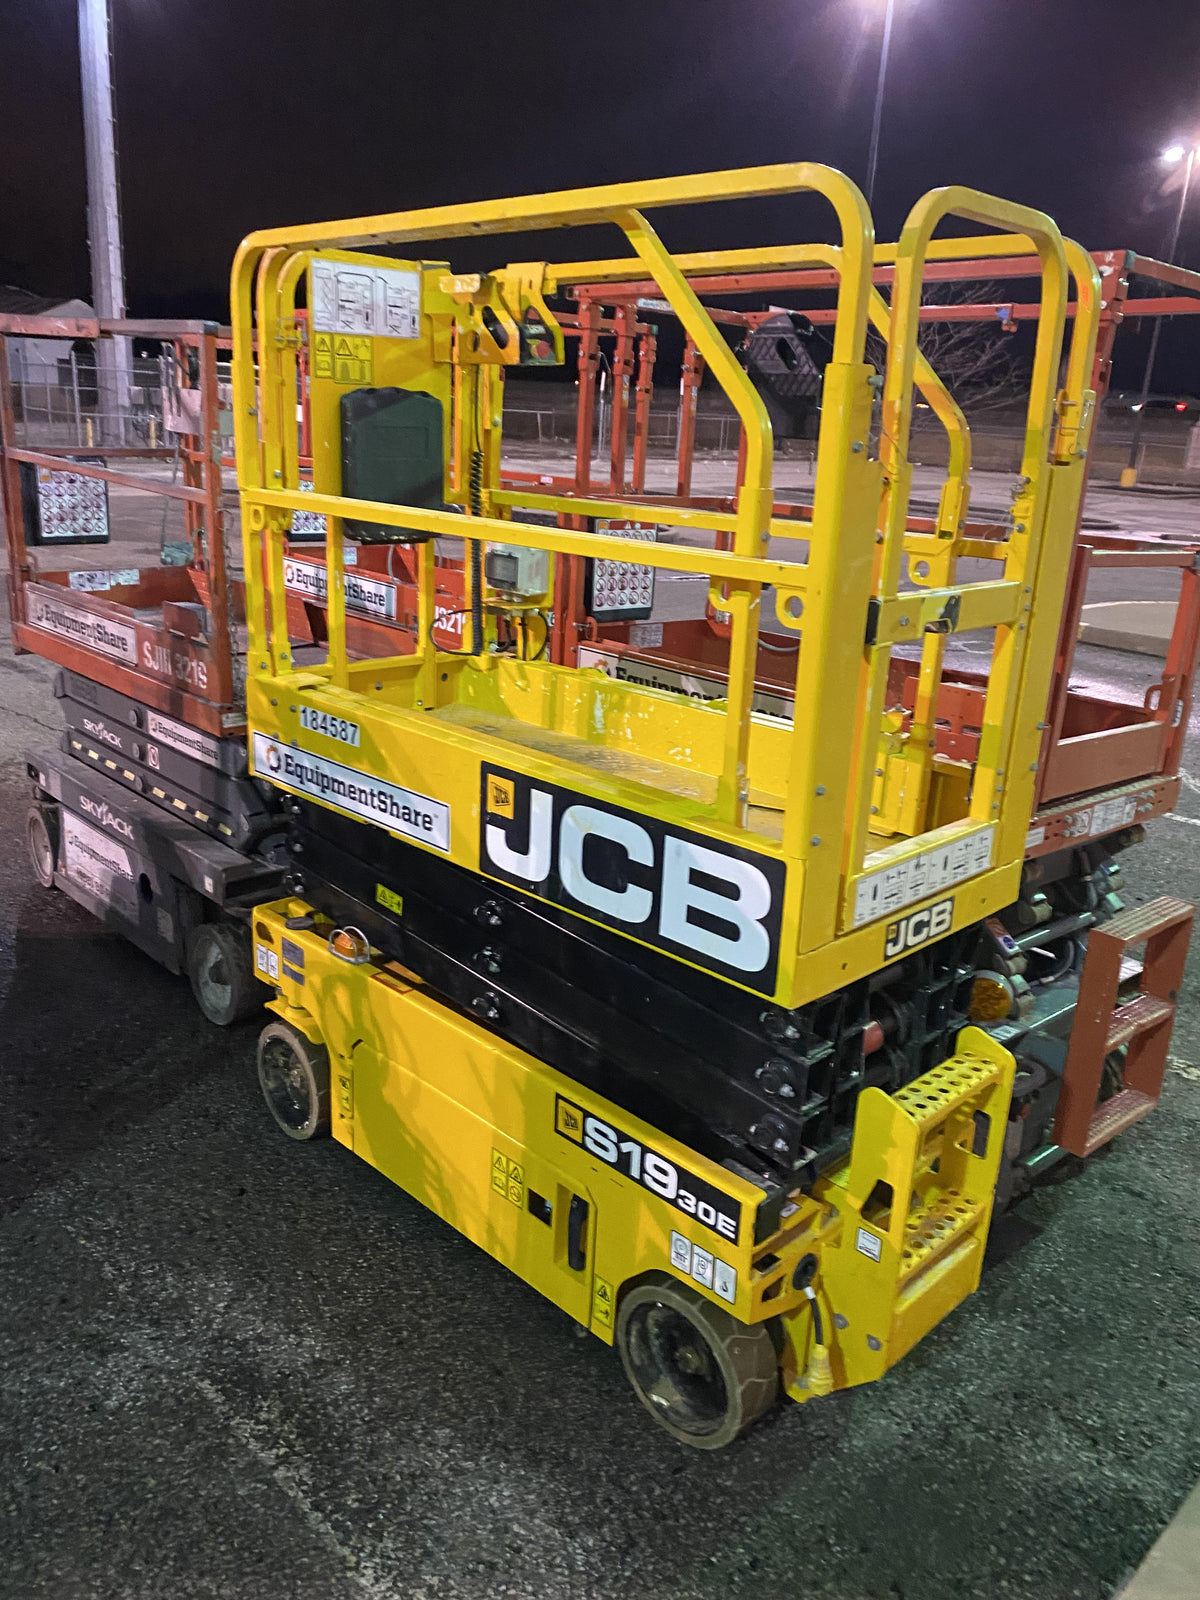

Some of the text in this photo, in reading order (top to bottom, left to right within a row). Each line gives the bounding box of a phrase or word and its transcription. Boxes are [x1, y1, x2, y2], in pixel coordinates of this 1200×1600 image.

[296, 568, 385, 607] EquiptShare
[44, 604, 128, 651] EquipmentShare
[301, 708, 359, 745] 184587
[284, 754, 434, 832] EquipmentShare
[80, 795, 135, 840] SKYJACK
[486, 788, 771, 973] JCB
[886, 900, 953, 957] JCB
